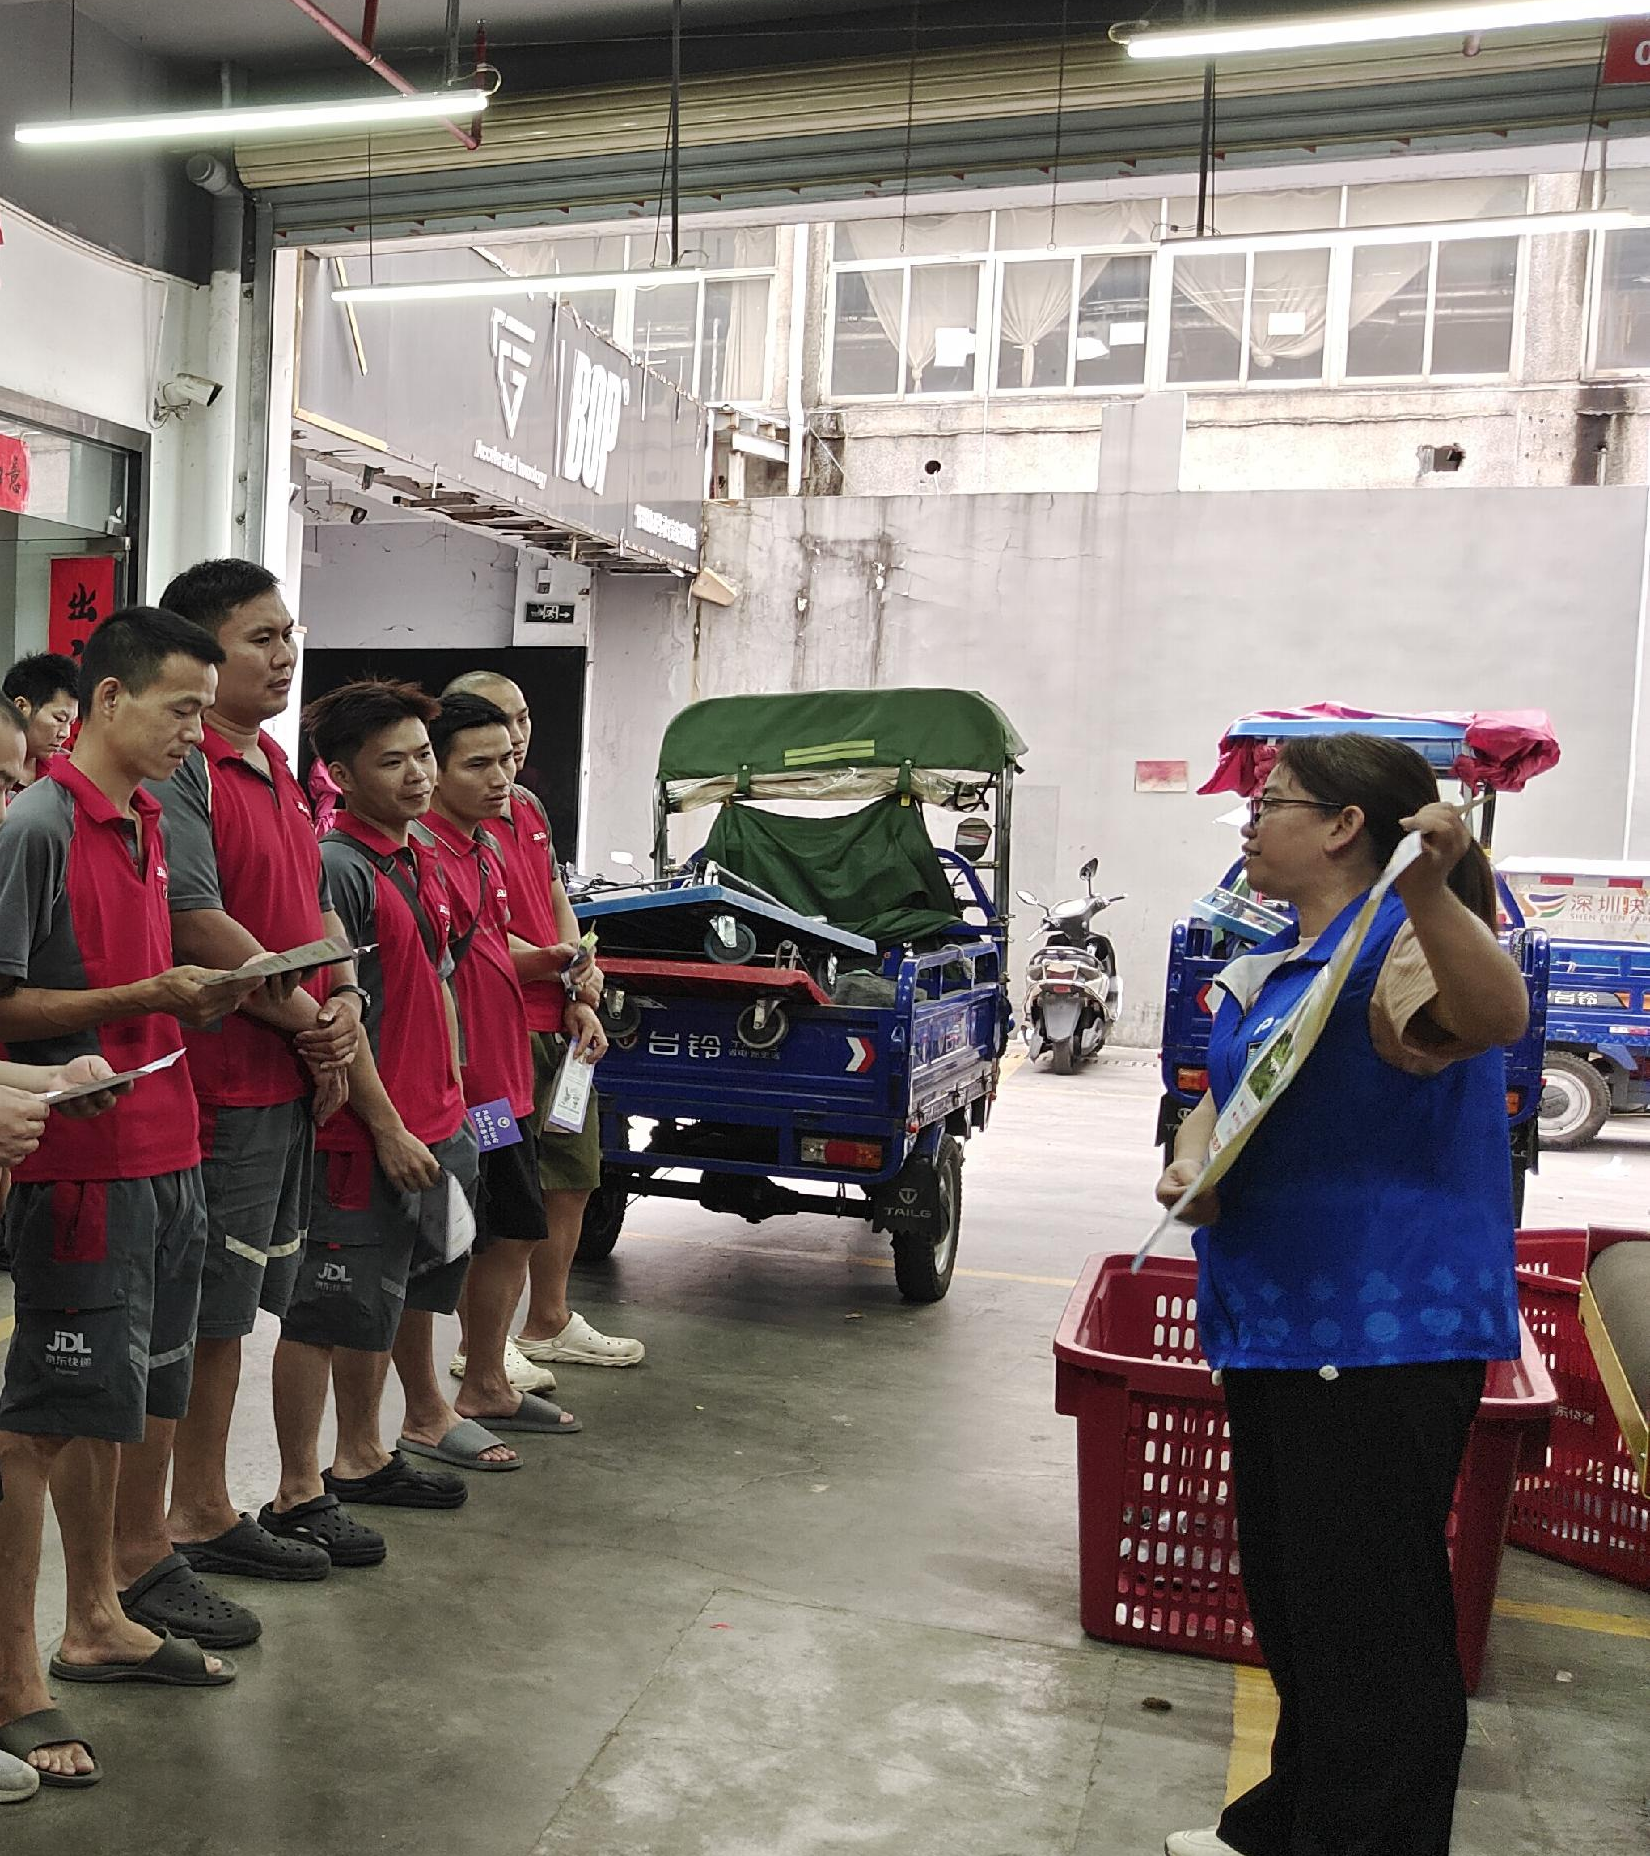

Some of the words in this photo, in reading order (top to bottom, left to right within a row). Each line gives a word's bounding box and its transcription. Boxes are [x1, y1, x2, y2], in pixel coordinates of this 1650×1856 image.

[649, 1031, 721, 1059] 台铃
[884, 1207, 932, 1219] TAILG
[317, 1262, 353, 1282] JDL
[46, 1330, 92, 1354] JDL
